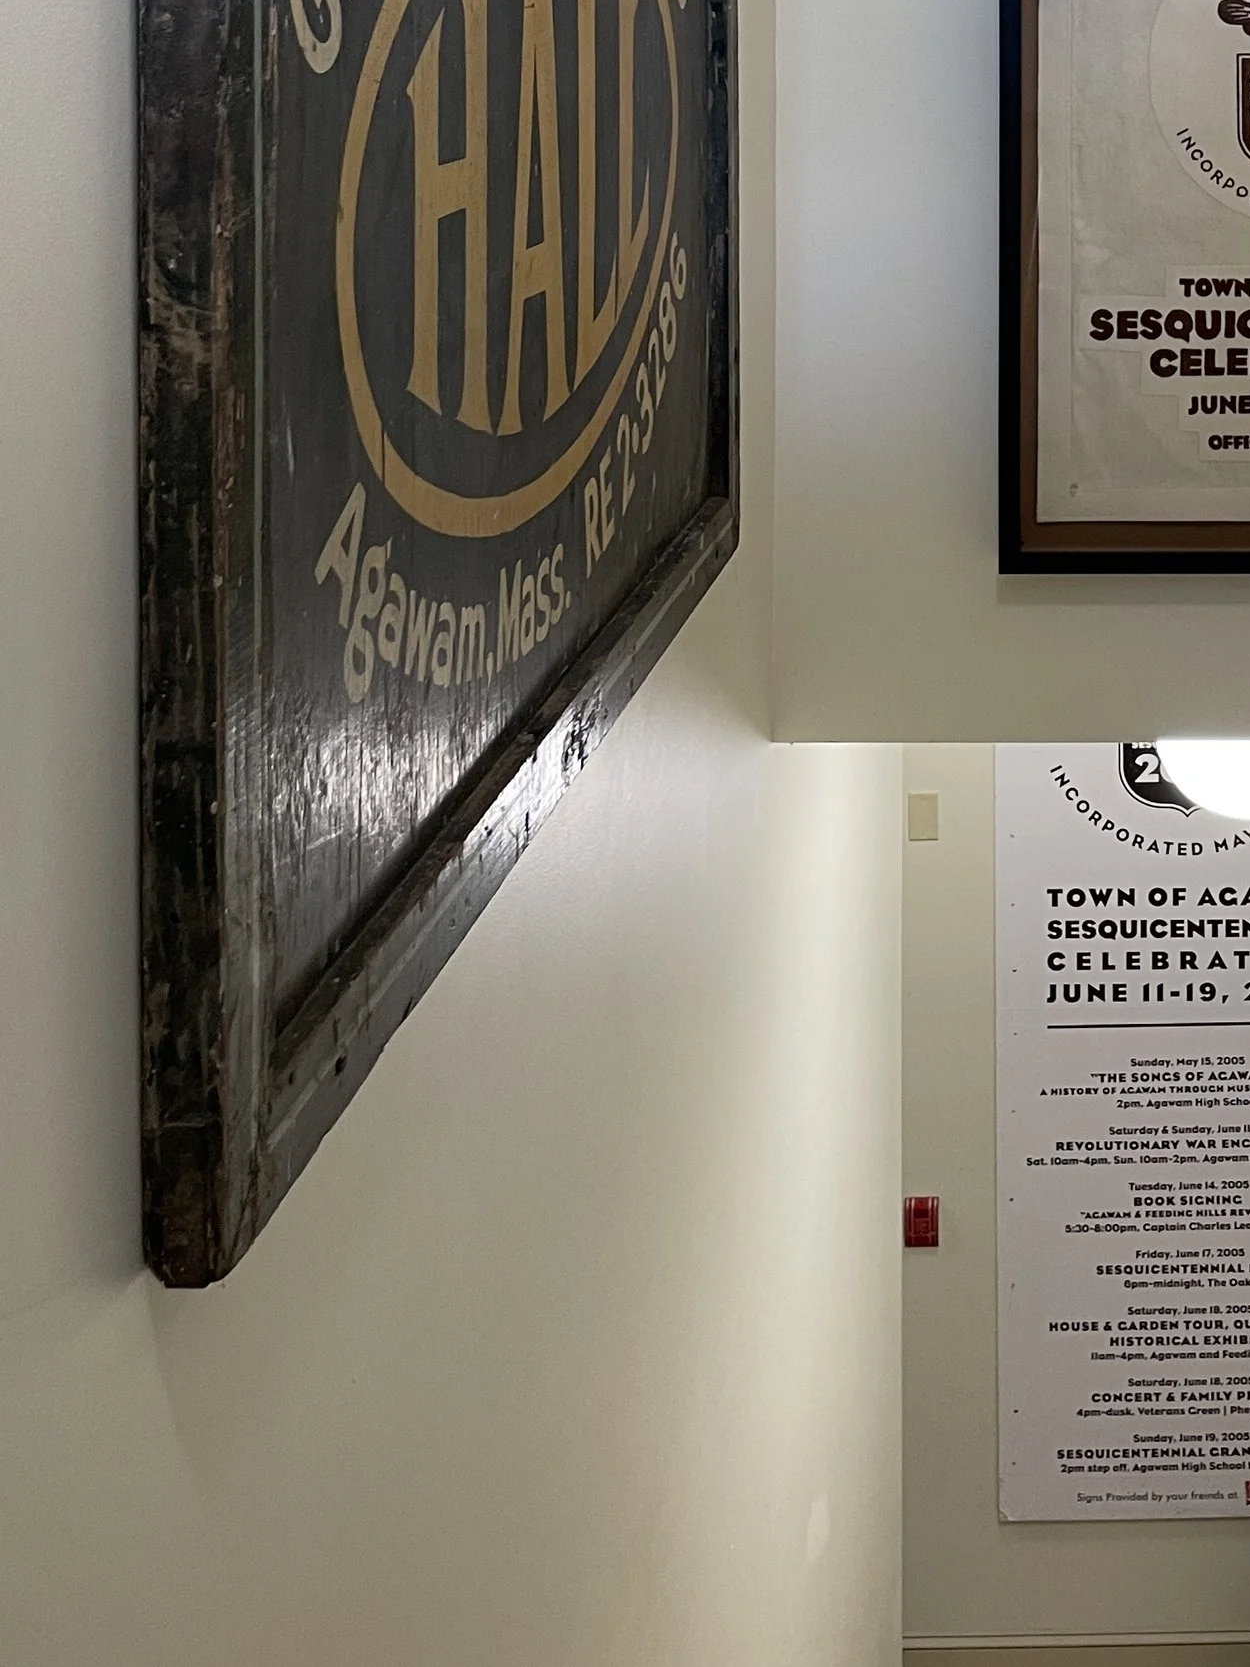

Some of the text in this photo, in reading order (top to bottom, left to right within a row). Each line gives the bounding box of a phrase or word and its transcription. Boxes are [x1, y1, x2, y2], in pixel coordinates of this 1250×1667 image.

[314, 482, 494, 703] Agawam,
[496, 543, 571, 672] Mass.
[584, 445, 615, 578] RE
[1050, 764, 1203, 856] INCORPORATED
[1045, 887, 1135, 908] TOWN
[1147, 886, 1187, 907] OF
[1046, 983, 1127, 1003] JUNE
[1142, 981, 1229, 1004] 11-19,
[1176, 1057, 1199, 1068] May
[1216, 1055, 1246, 1065] 2005
[1130, 1071, 1181, 1083] SONGS
[1184, 1071, 1204, 1082] OF
[1039, 1088, 1048, 1096] A
[1049, 1087, 1099, 1096] HISTORY
[1101, 1086, 1116, 1095] OF
[1118, 1085, 1166, 1095] AGAWAM
[1168, 1084, 1224, 1094] THROUGH
[1145, 1099, 1193, 1110] Agawam
[1194, 1097, 1221, 1109] High
[1108, 1125, 1160, 1136] Saturday
[1160, 1124, 1169, 1135] &
[1216, 1123, 1241, 1134] June
[1055, 1139, 1180, 1151] REVOLUTIONARY
[1184, 1138, 1217, 1149] WAR
[1201, 1153, 1249, 1165] Agawam
[1177, 1181, 1203, 1190] June
[1220, 1179, 1250, 1190] 2005
[1133, 1194, 1243, 1207] BOOK SIGNING
[1133, 1209, 1142, 1218] &
[1144, 1209, 1193, 1218] FEEDING
[1195, 1208, 1227, 1217] HILLS
[1142, 1222, 1186, 1233] Captain
[1188, 1221, 1231, 1231] Charles
[1174, 1249, 1200, 1258] June
[1216, 1247, 1245, 1257] 2005
[1095, 1262, 1245, 1275] SESQUICENTENNIAL
[1206, 1277, 1227, 1287] The
[1182, 1305, 1207, 1315] June
[1048, 1320, 1099, 1332] HOUSE
[1102, 1320, 1112, 1332] &
[1116, 1319, 1179, 1331] GARDEN
[1109, 1335, 1200, 1347] HISTORICAL
[1149, 1351, 1197, 1362] Agawam
[1198, 1349, 1220, 1359] and
[1183, 1377, 1208, 1386] June
[1090, 1391, 1162, 1403] CONCERT
[1165, 1391, 1175, 1402] &
[1180, 1390, 1232, 1402] FAMILY
[1136, 1406, 1186, 1416] Veterans
[1187, 1405, 1221, 1415] Green
[1178, 1432, 1203, 1442] June
[1220, 1431, 1250, 1441] 2005
[1056, 1446, 1206, 1460] SESQUICENTENNIAL
[1060, 1463, 1085, 1474] 2pm
[1086, 1463, 1111, 1474] step
[1131, 1462, 1179, 1474] Agawam
[1180, 1461, 1207, 1473] High
[1208, 1460, 1246, 1471] School
